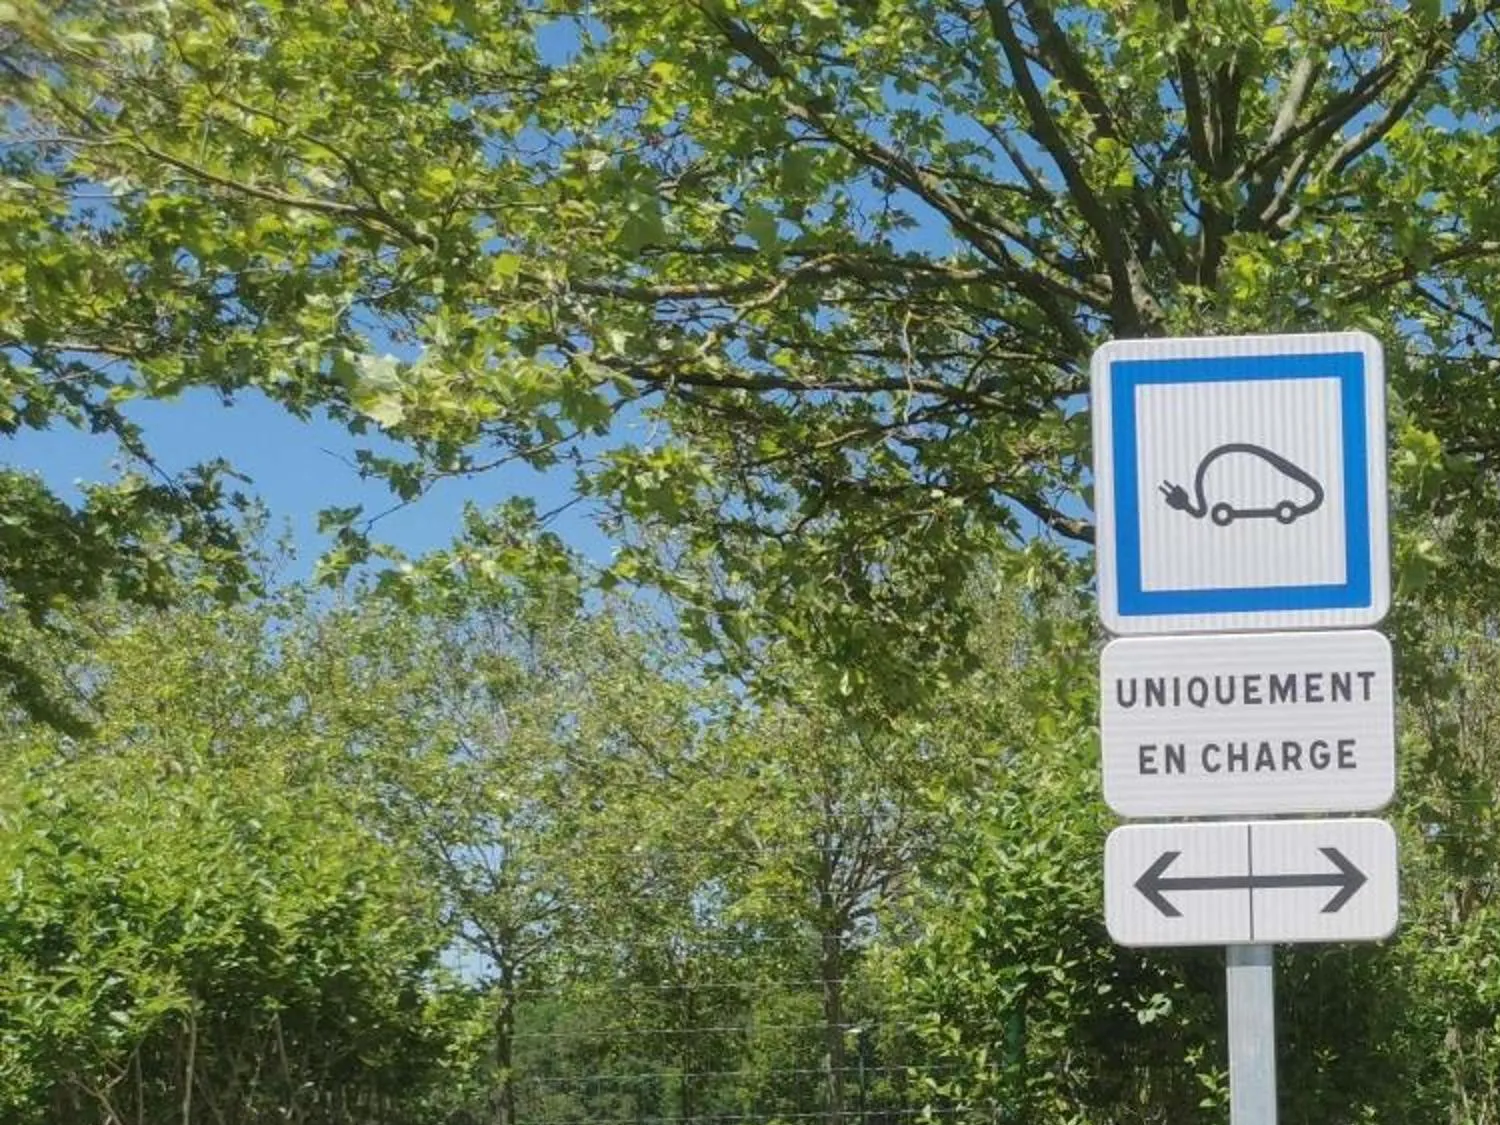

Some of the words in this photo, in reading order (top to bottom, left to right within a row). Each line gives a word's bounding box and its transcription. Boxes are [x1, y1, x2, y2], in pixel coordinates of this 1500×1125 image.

[1116, 671, 1376, 708] UNIQUEMENT
[1138, 743, 1186, 775] EN
[1201, 739, 1358, 773] CHARGE
